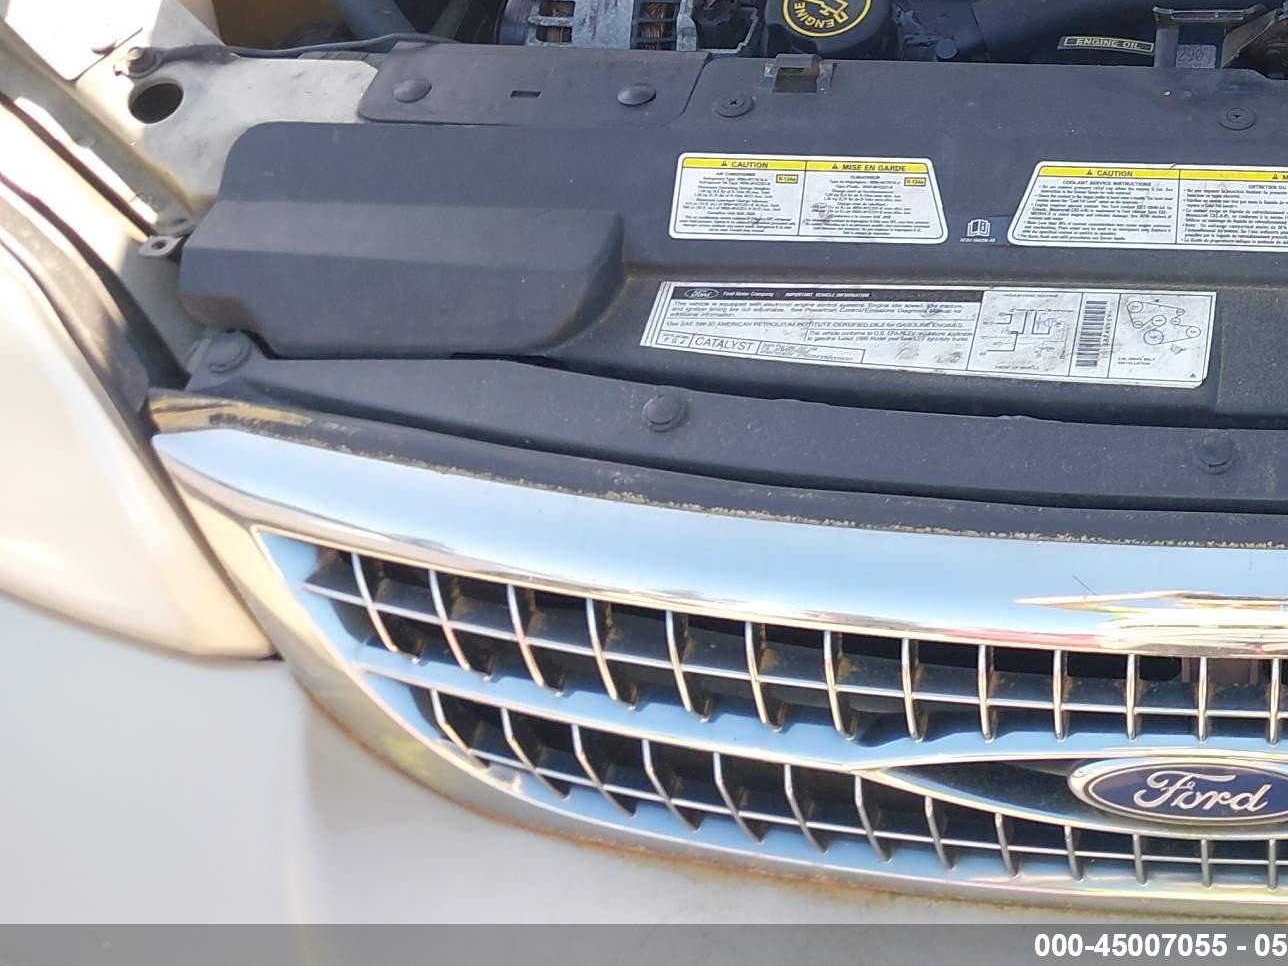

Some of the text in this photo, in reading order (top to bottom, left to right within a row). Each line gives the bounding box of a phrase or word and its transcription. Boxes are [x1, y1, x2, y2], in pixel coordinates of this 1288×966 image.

[793, 1, 835, 28] ENGINE
[1076, 38, 1140, 49] ENGINE OIL
[690, 290, 712, 298] Ford
[694, 336, 753, 352] CATALYST
[1133, 770, 1272, 812] Ford
